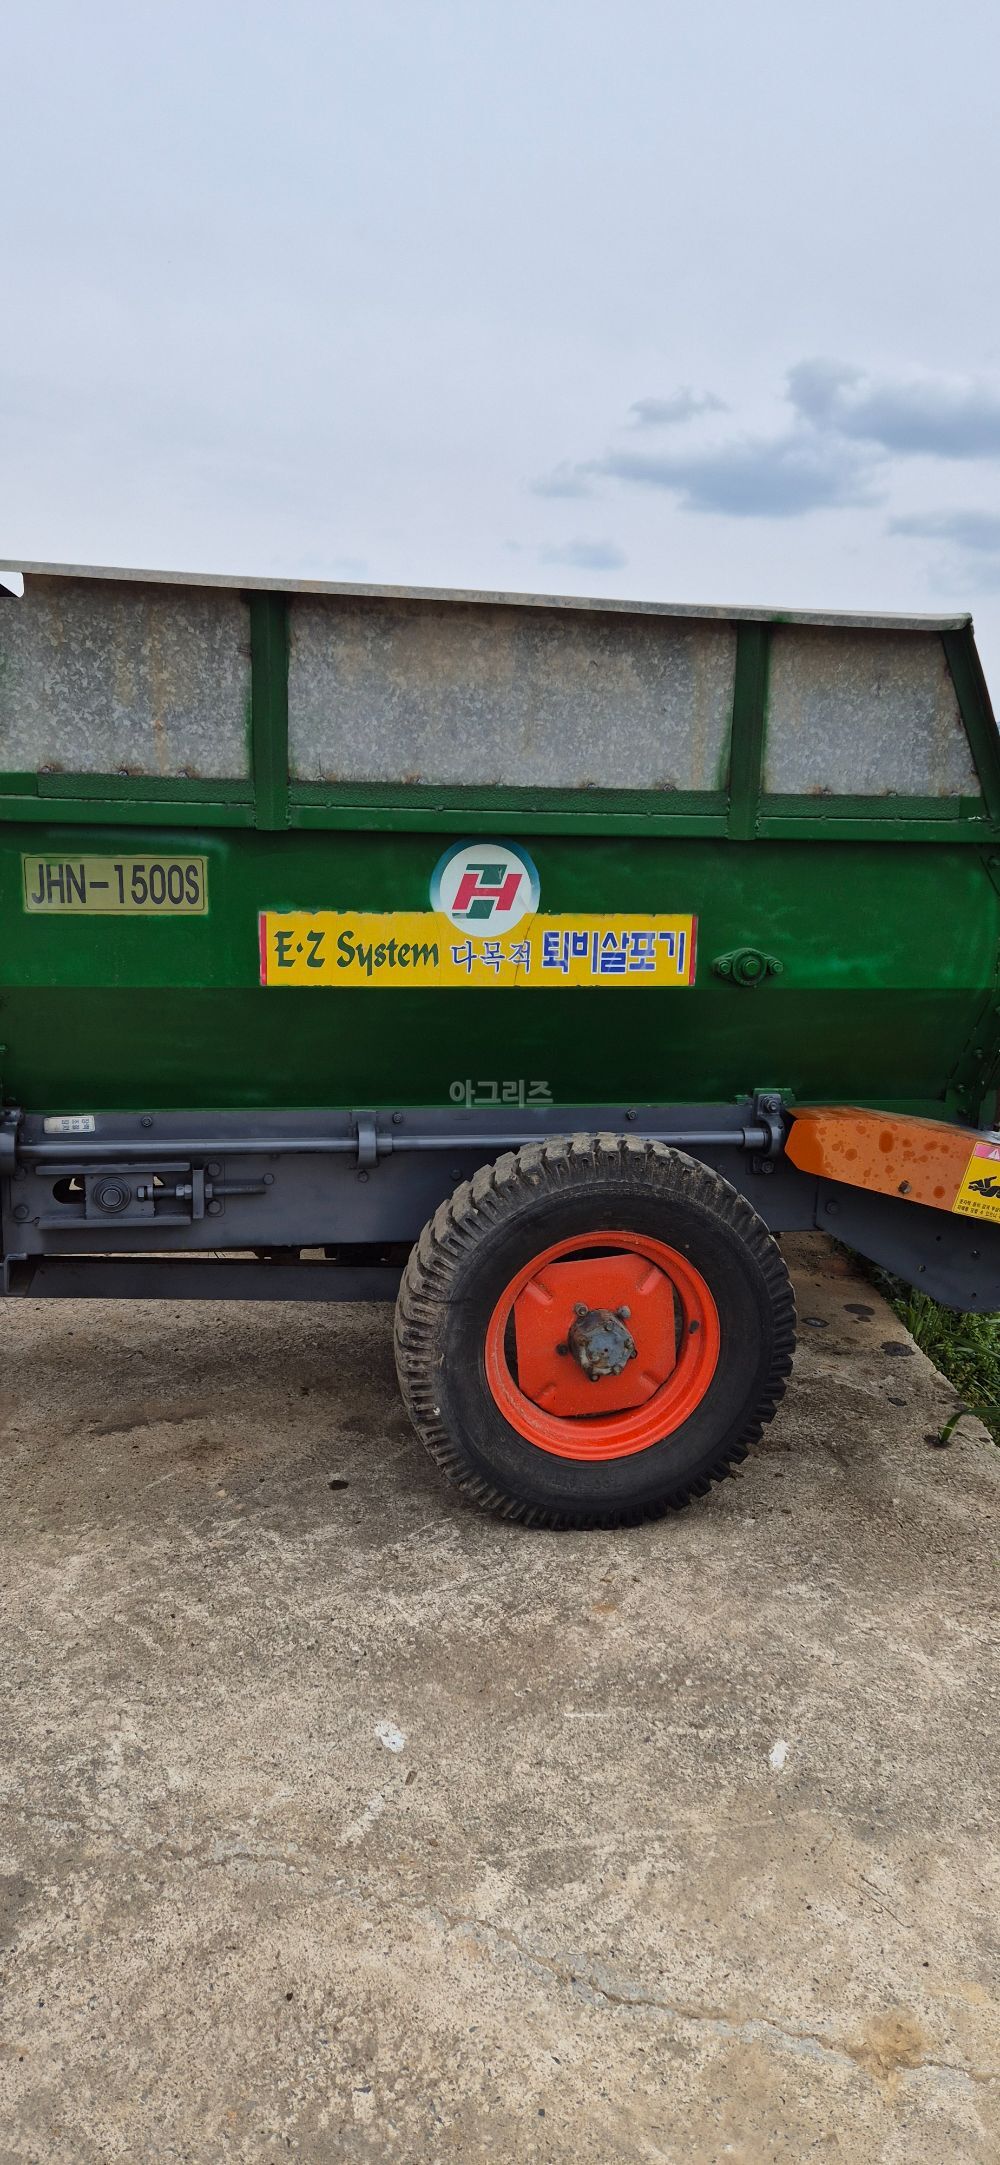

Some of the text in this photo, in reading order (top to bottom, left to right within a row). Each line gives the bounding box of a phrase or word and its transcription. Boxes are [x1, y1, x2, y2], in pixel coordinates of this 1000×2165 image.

[31, 863, 200, 905] JHN-1500S
[336, 930, 439, 977] System
[450, 939, 532, 974] 다목적
[541, 931, 685, 974] 퇴비살포기
